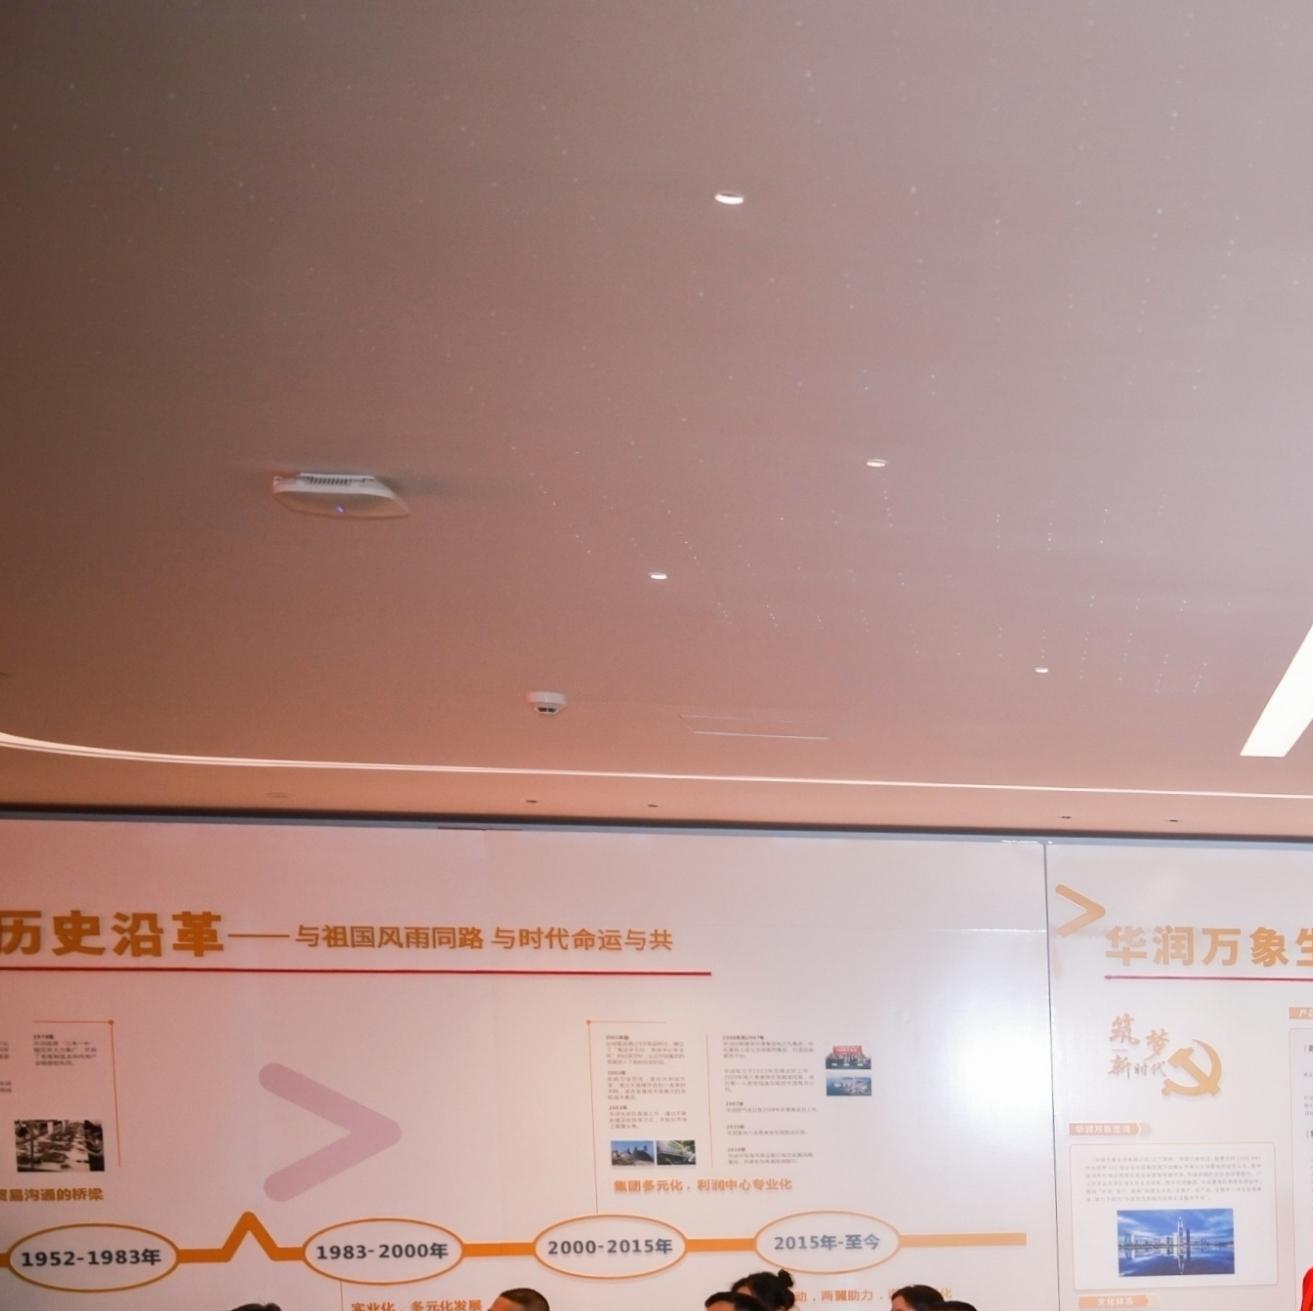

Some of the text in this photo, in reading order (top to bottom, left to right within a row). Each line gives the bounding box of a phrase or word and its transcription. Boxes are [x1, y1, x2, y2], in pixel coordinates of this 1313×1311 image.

[0, 909, 224, 957] 历史沿革
[492, 928, 674, 951] 与时代命运与共
[315, 1242, 449, 1261] 1983-2000年
[547, 1237, 673, 1257] 2000-2015年
[773, 1233, 881, 1252] 2015年-至今
[20, 1247, 163, 1268] 1952-1983年
